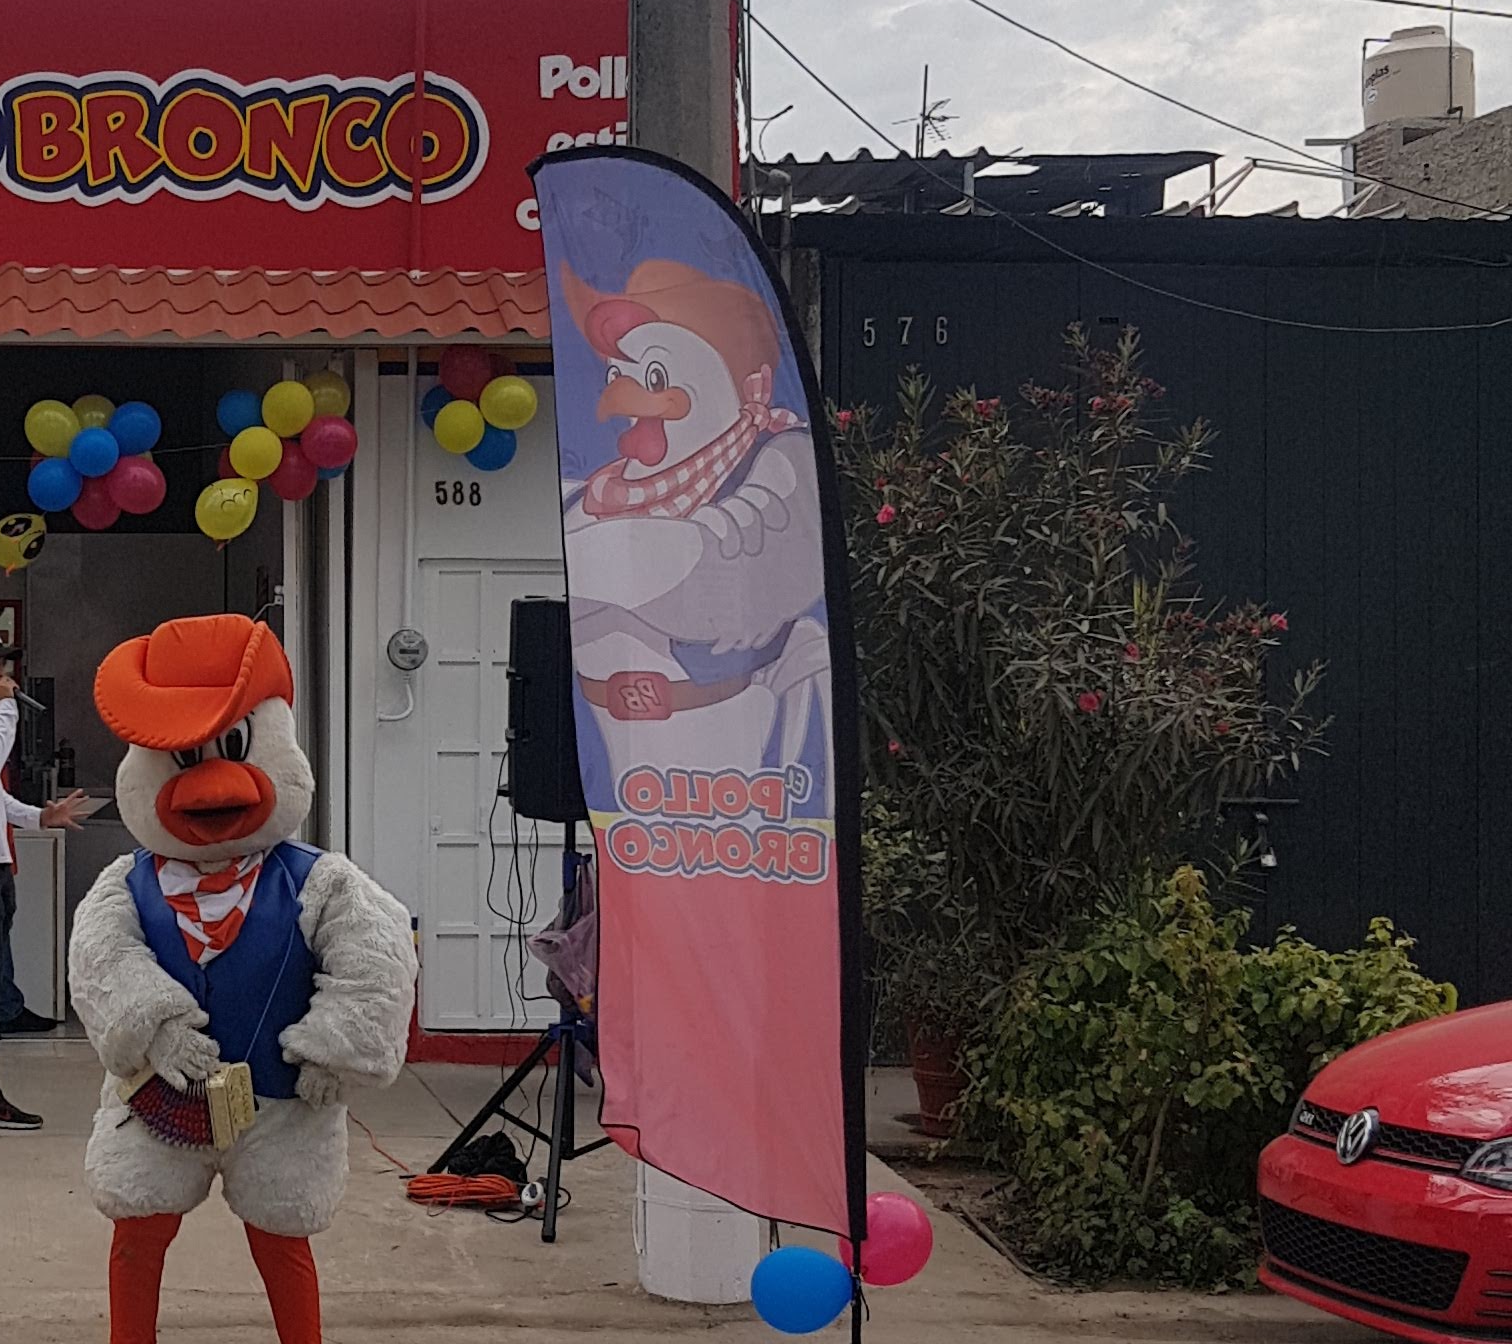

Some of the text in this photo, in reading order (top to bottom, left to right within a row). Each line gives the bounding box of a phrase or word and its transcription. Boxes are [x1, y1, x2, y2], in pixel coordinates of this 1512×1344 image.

[540, 55, 629, 99] Poll
[8, 77, 475, 196] BRONCO
[862, 316, 948, 346] 576
[434, 480, 482, 506] 588
